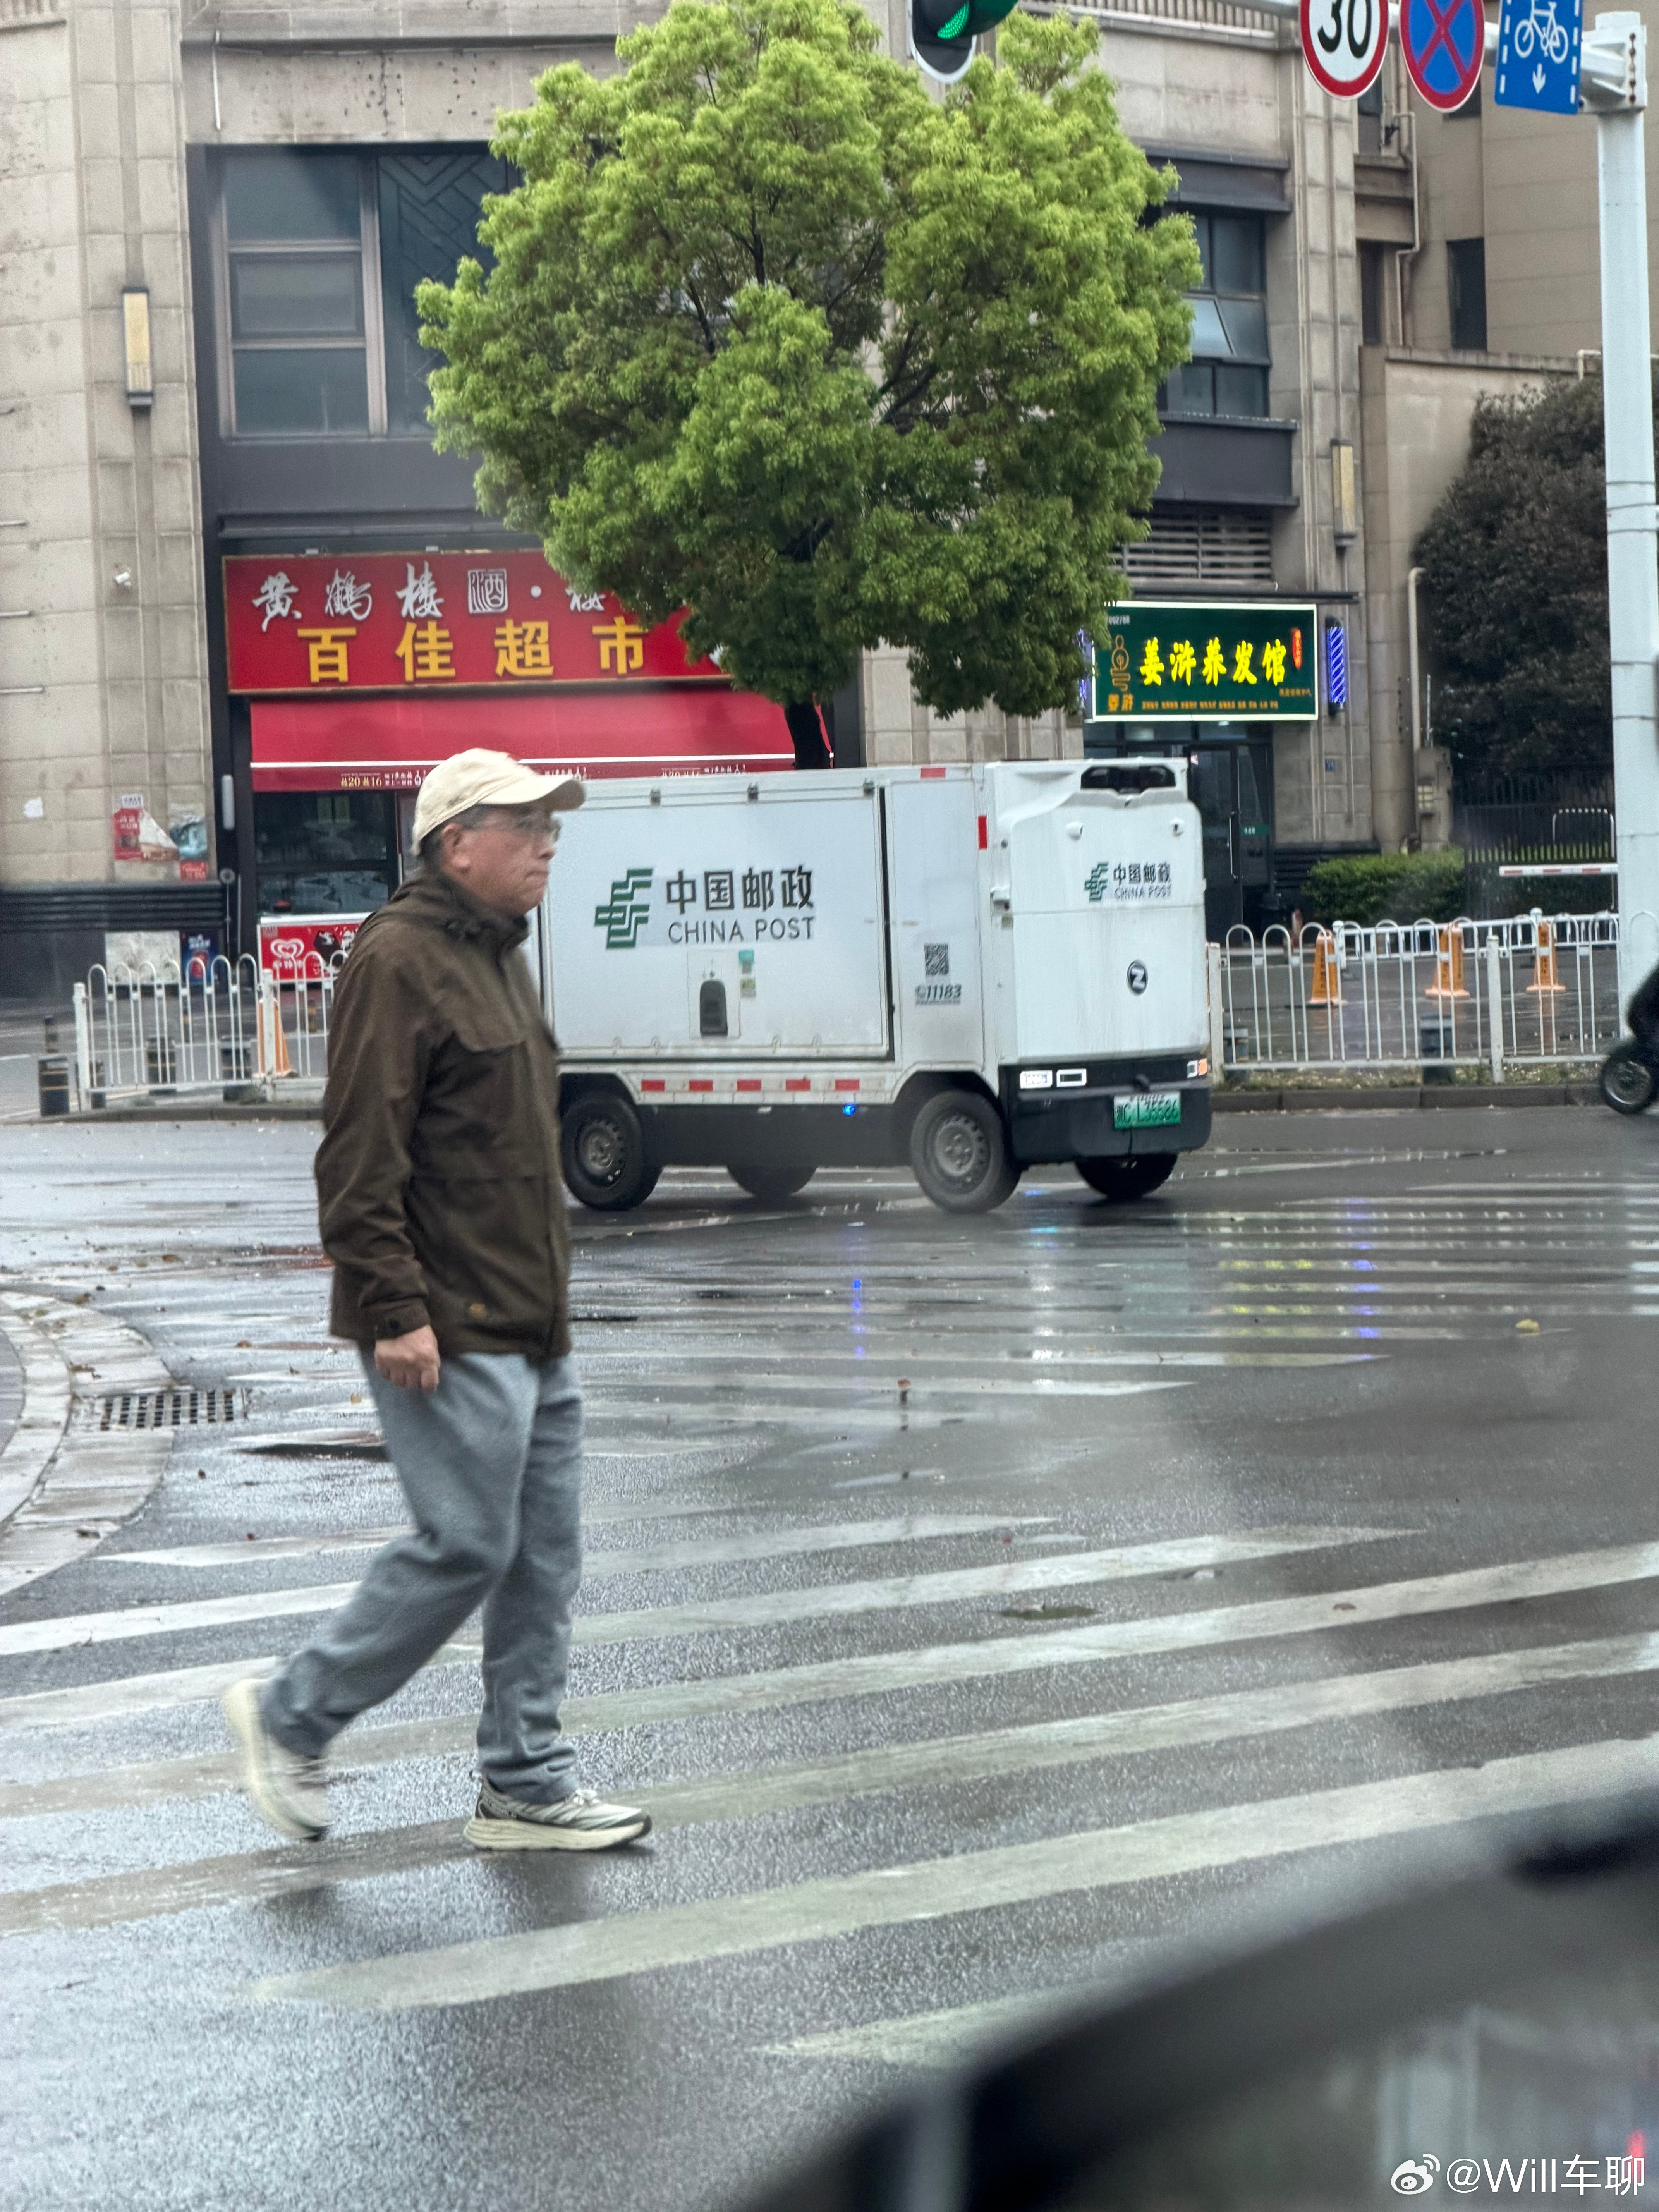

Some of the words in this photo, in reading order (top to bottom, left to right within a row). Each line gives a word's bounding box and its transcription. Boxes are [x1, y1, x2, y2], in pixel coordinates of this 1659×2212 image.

[1317, 0, 1372, 58] 30
[297, 616, 648, 683] 百佳超市
[666, 865, 814, 915] 中国邮政
[1113, 862, 1171, 886] 中国邮政
[668, 919, 744, 944] CHINA
[755, 916, 816, 941] POST
